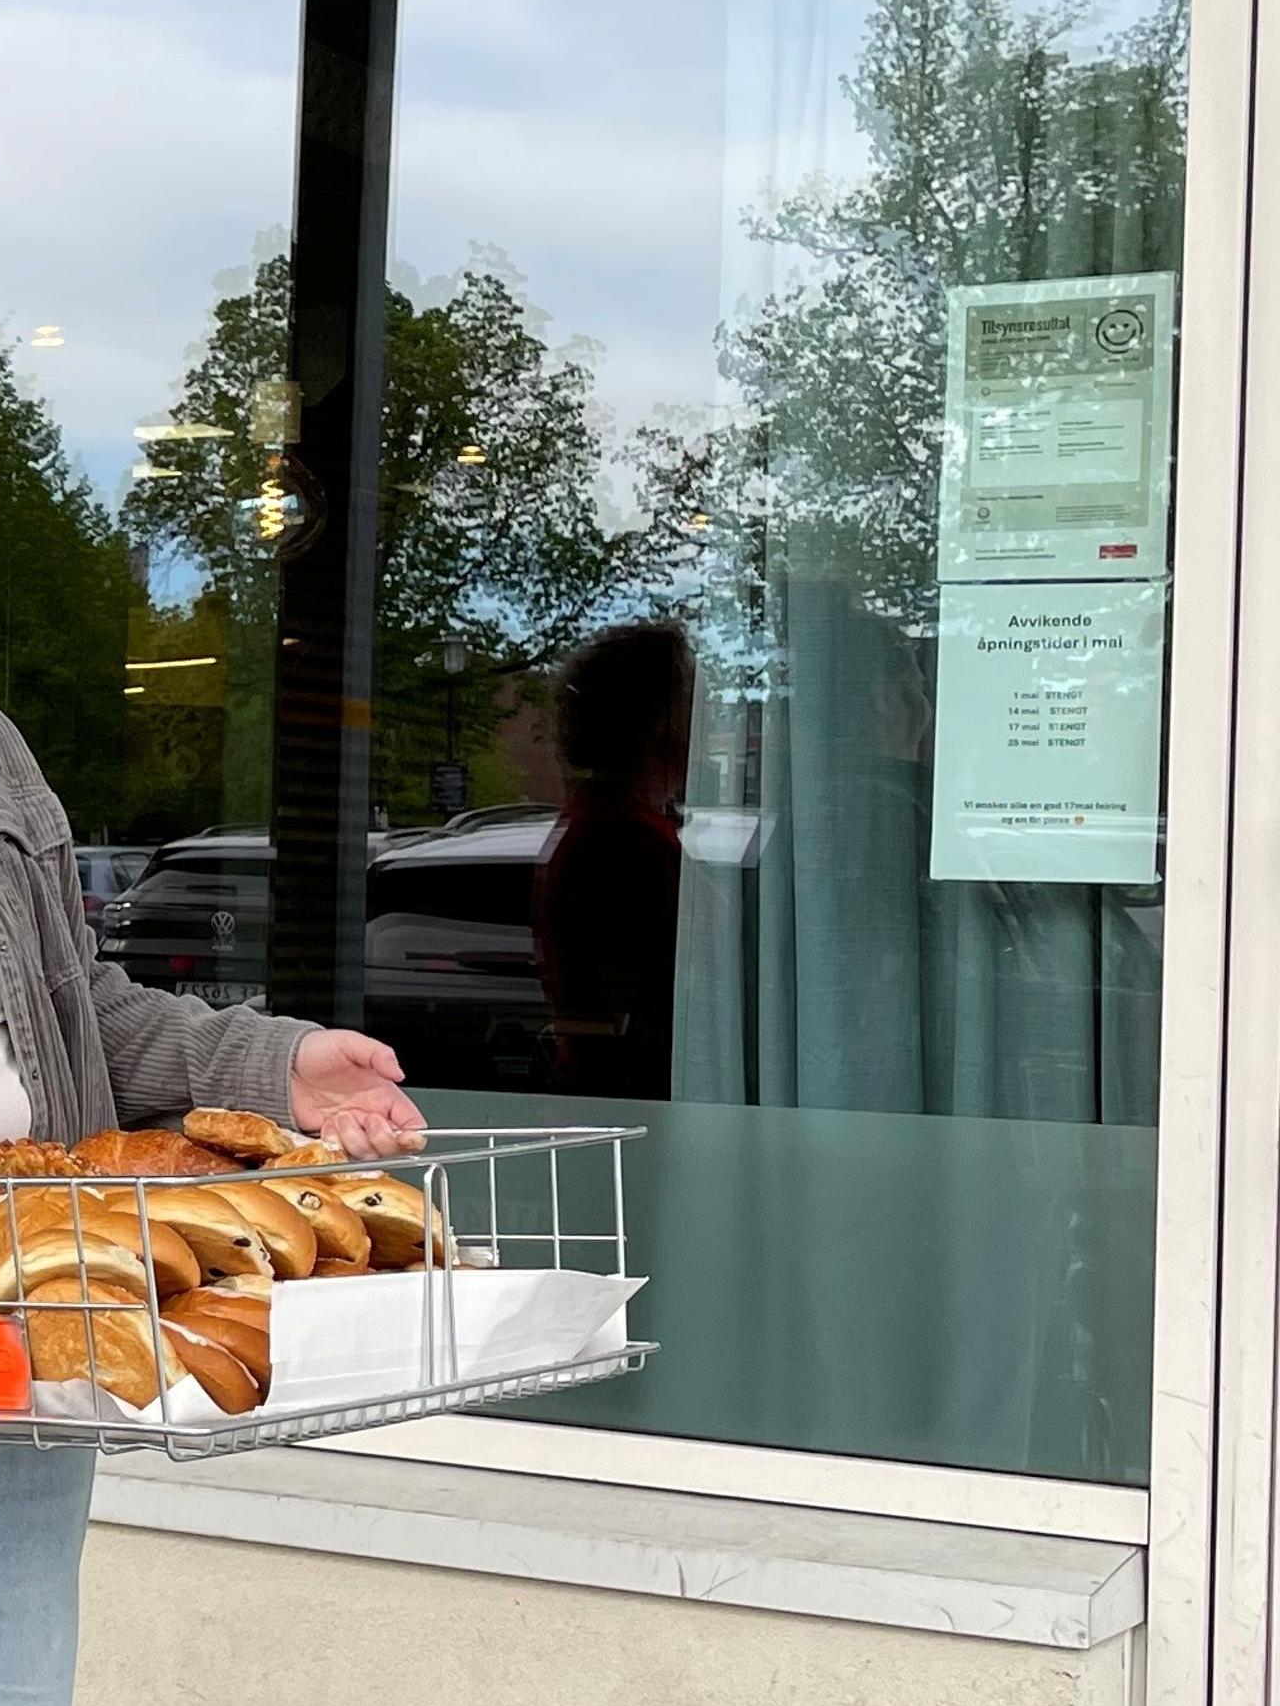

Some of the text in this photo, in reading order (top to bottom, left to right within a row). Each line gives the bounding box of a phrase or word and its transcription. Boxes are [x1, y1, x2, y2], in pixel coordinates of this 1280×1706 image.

[981, 316, 1071, 337] Tilsynsresultat
[1008, 614, 1093, 628] Avvikende
[977, 636, 1080, 653] åpningstider
[1092, 635, 1123, 649] mai
